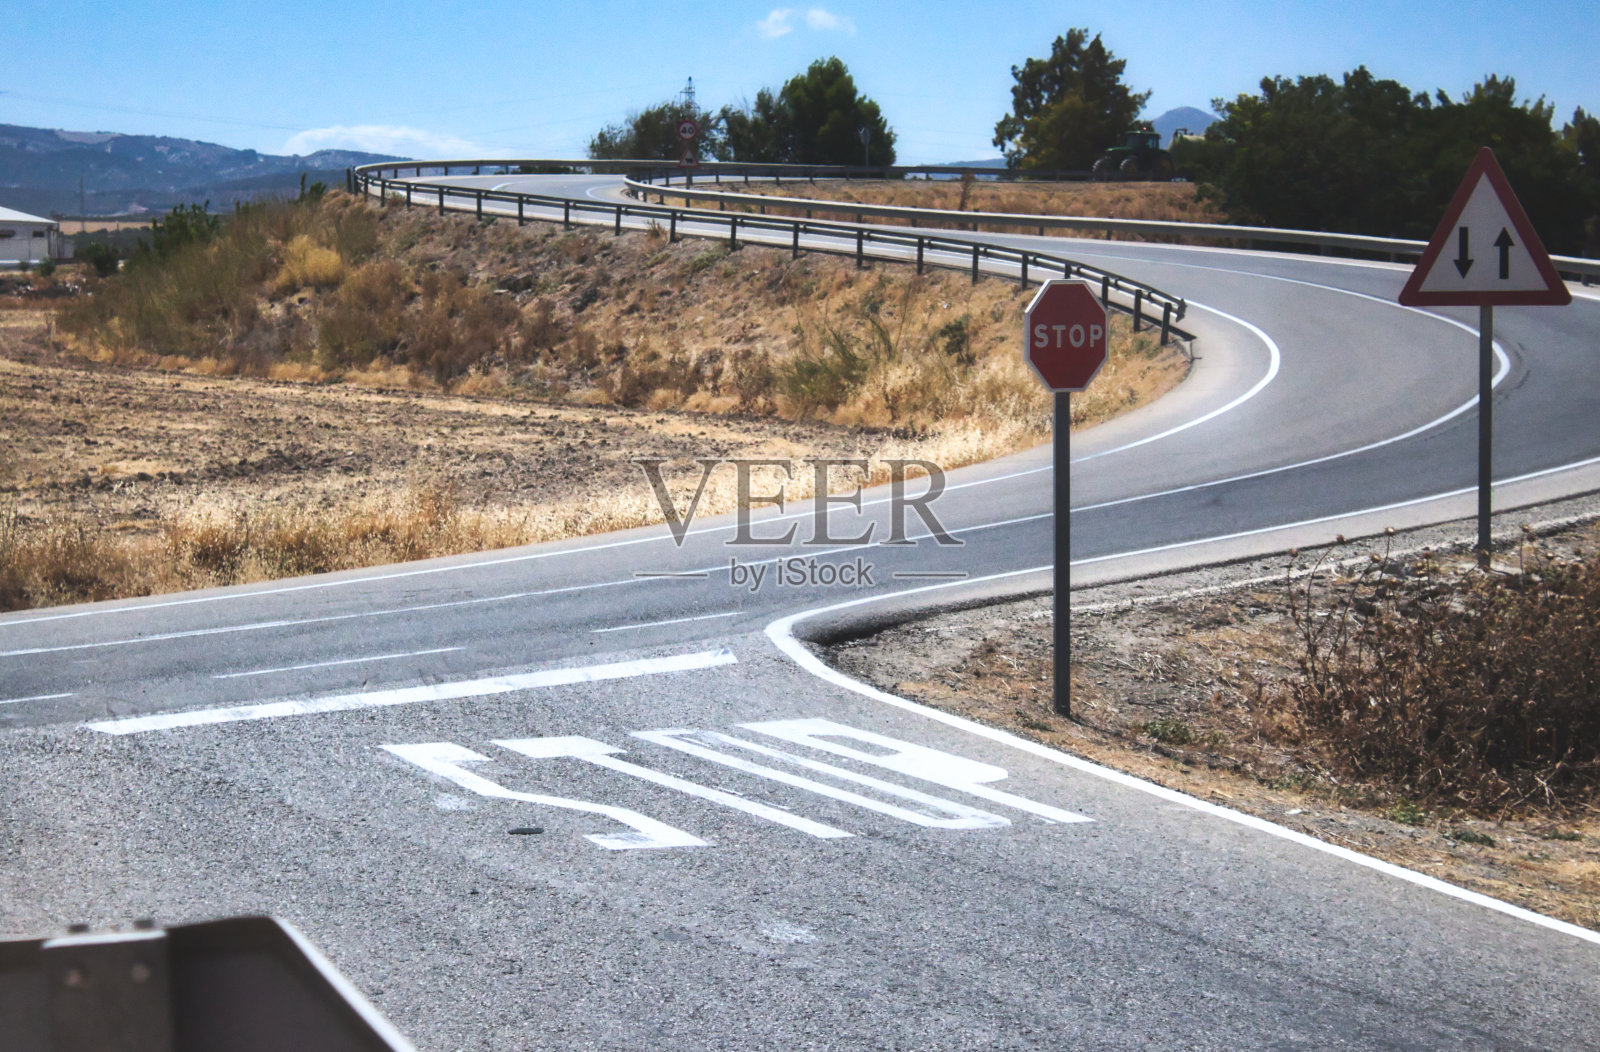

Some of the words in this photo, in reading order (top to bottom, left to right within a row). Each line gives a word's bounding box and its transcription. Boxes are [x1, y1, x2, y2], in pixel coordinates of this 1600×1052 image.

[681, 126, 694, 135] 40
[1034, 324, 1103, 349] STOP
[379, 718, 1096, 850] STOP
